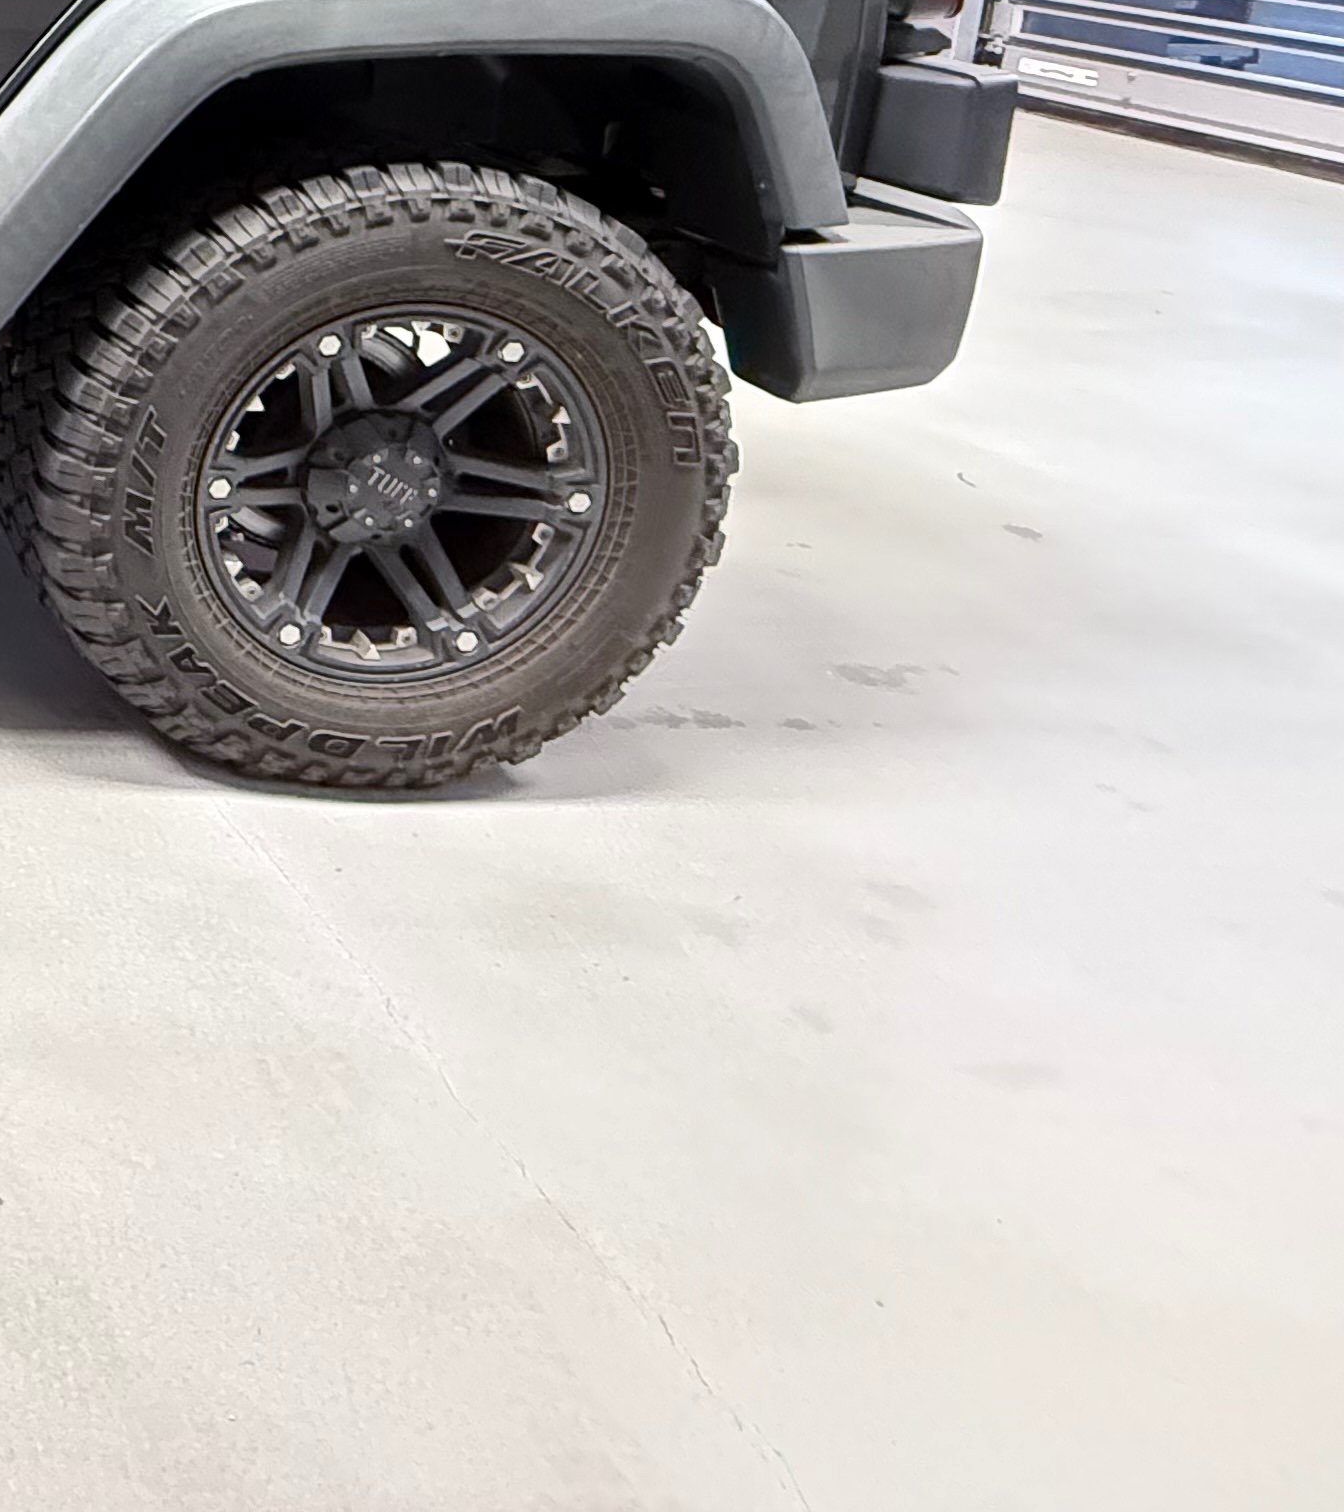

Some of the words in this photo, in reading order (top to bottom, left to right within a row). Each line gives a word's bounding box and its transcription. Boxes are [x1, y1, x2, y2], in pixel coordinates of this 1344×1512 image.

[122, 404, 168, 560] M/T
[367, 466, 419, 505] TUFF
[134, 593, 523, 761] WILDPEAK
